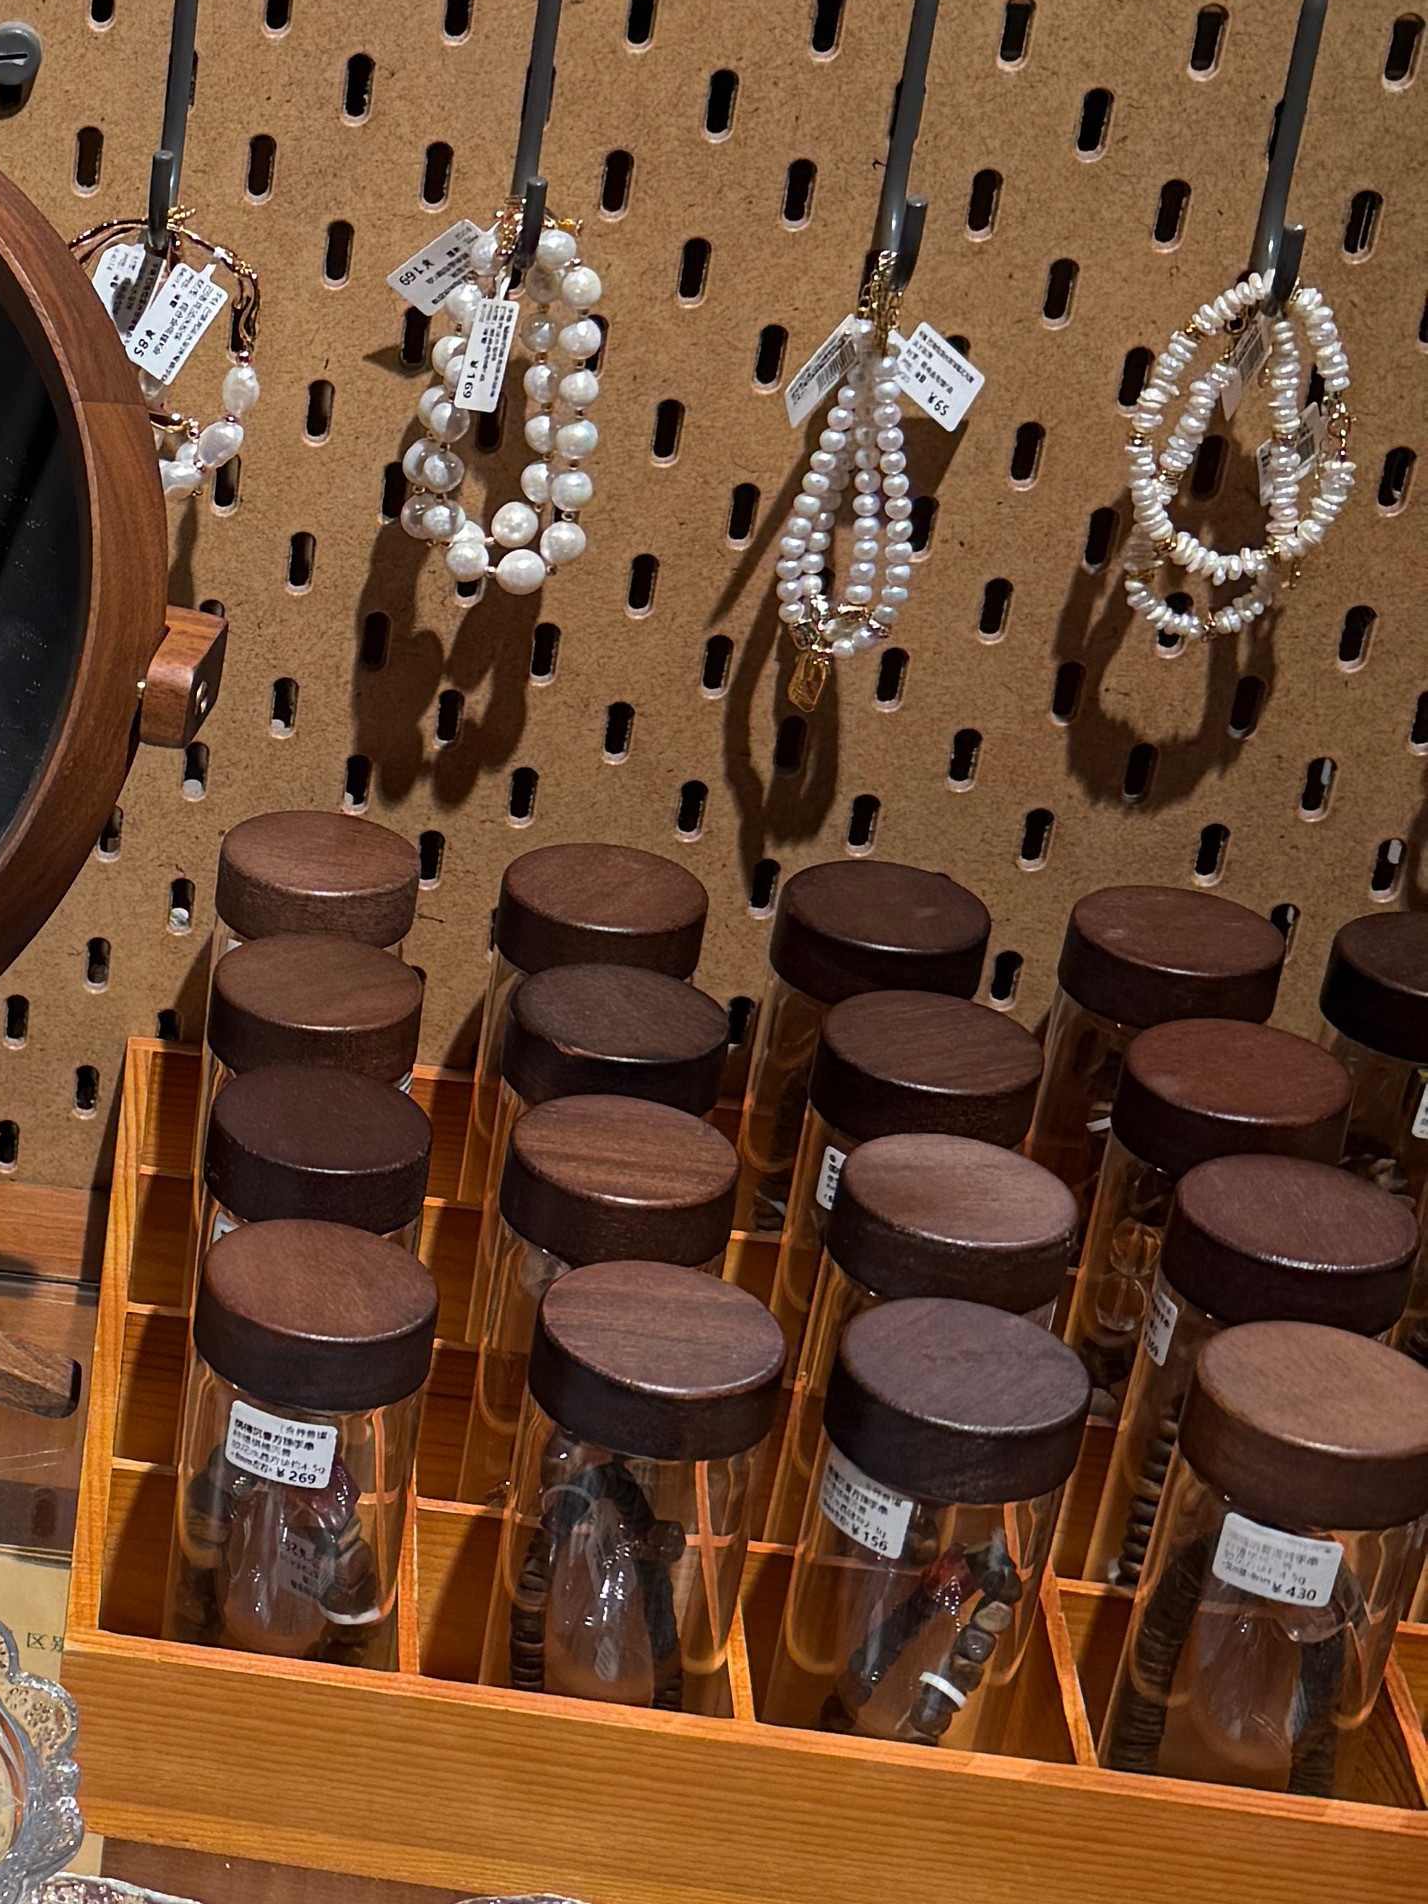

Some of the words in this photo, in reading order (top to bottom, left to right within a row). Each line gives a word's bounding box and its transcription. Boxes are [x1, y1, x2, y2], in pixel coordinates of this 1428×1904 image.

[463, 360, 479, 398] ¥169
[928, 392, 950, 416] ¥65
[276, 1467, 316, 1484] ¥269
[852, 1524, 888, 1551] ¥156
[1272, 1581, 1317, 1601] ¥430
